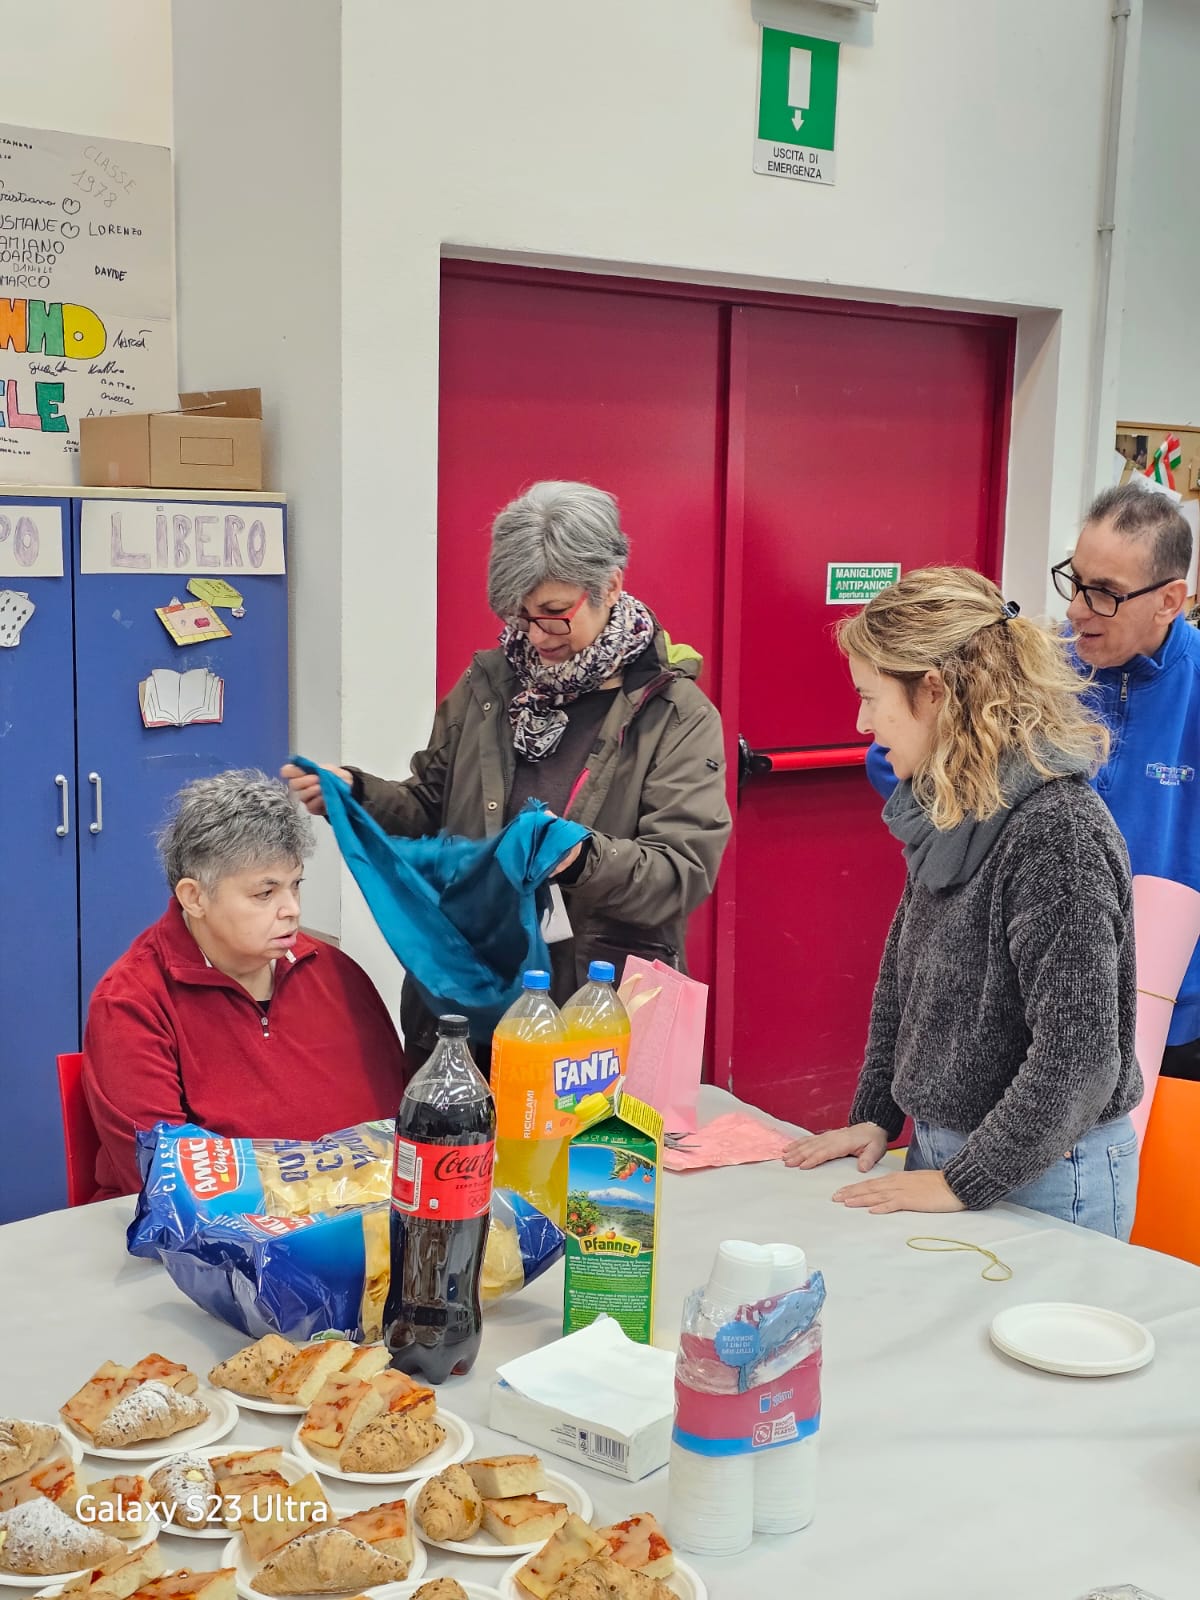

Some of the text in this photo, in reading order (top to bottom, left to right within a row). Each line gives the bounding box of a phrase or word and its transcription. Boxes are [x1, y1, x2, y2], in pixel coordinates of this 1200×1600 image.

[773, 147, 819, 164] USCITA DI
[767, 161, 822, 180] EMERGENZA
[88, 221, 142, 237] LORENZO
[0, 250, 57, 265] OARDO
[94, 265, 127, 281] DAVIDE
[0, 379, 70, 433] LE
[835, 568, 893, 578] MANIGLIONE
[835, 580, 892, 591] ANTIPANICO
[554, 1050, 620, 1091] FANTA
[523, 1090, 535, 1139] RICICLAMI
[189, 1138, 218, 1193] AMIC
